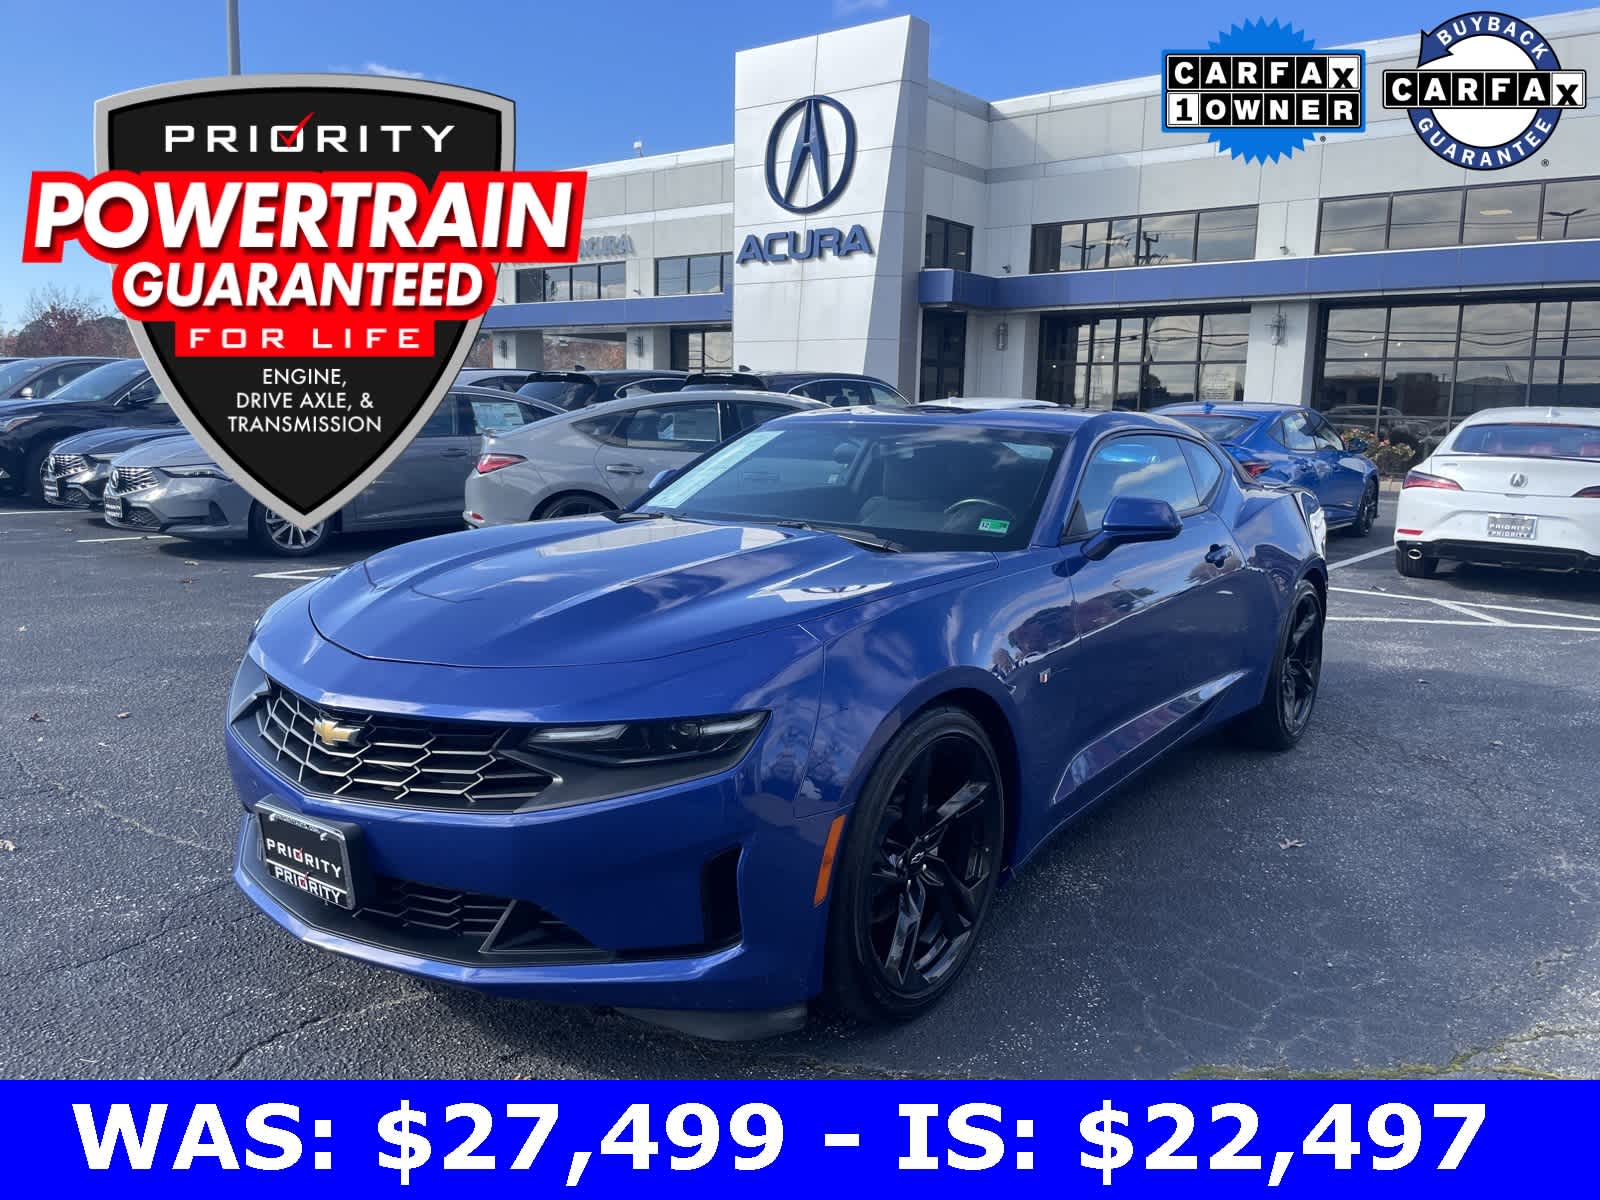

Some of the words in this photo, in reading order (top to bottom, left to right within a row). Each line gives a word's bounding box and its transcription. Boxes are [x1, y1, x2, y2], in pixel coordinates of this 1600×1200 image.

[736, 224, 873, 264] ACURA
[266, 838, 341, 878] PRIORITY
[274, 866, 341, 904] PRIORITY
